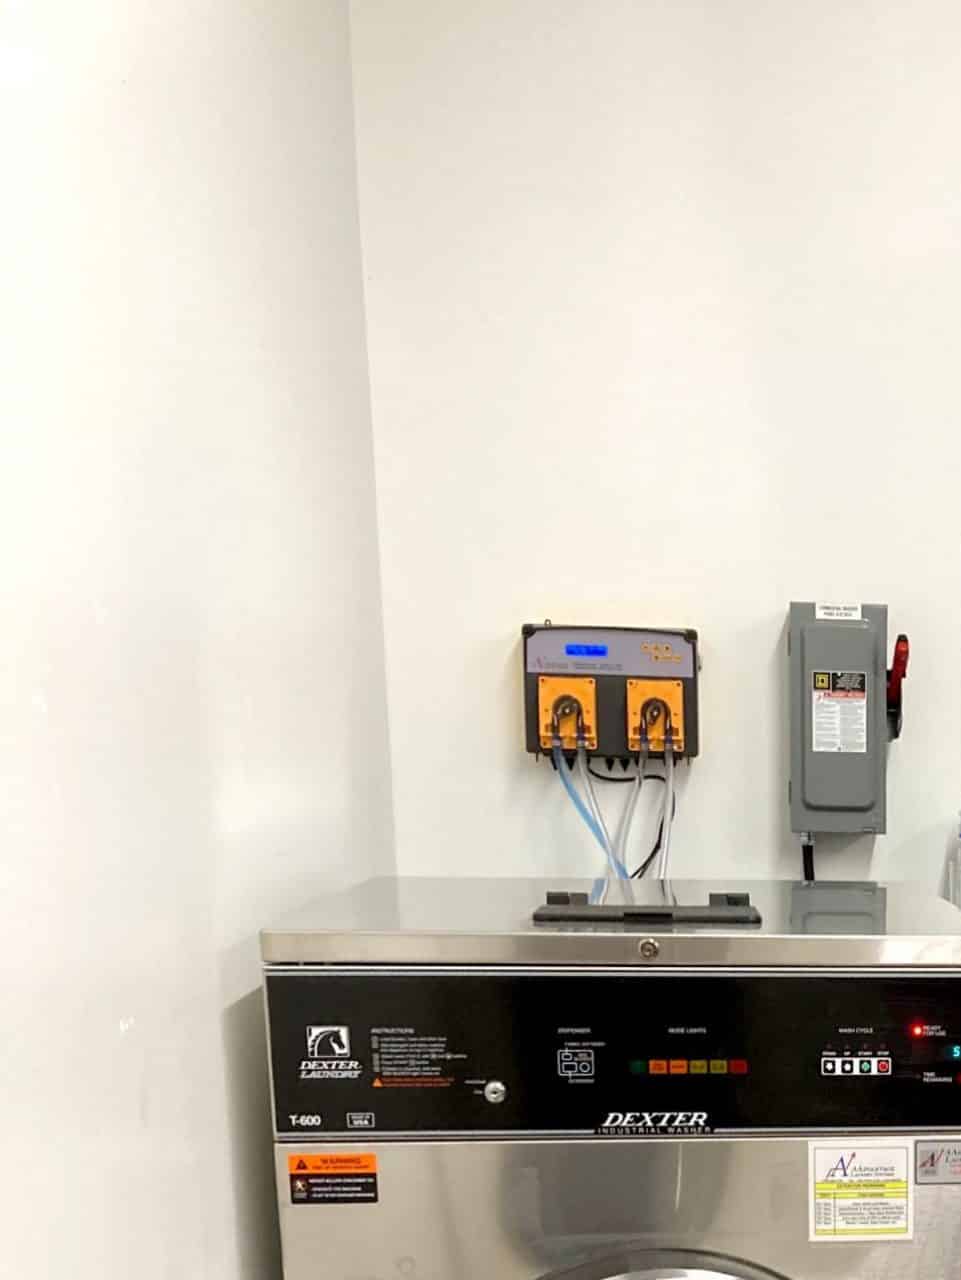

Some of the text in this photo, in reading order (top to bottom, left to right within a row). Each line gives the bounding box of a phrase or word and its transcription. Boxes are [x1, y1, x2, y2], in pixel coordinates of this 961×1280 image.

[299, 1060, 363, 1071] DEXTER
[288, 1114, 322, 1127] T-600
[601, 1111, 709, 1128] DEXTER
[598, 1125, 712, 1136] INDUSTRIAL WASHER
